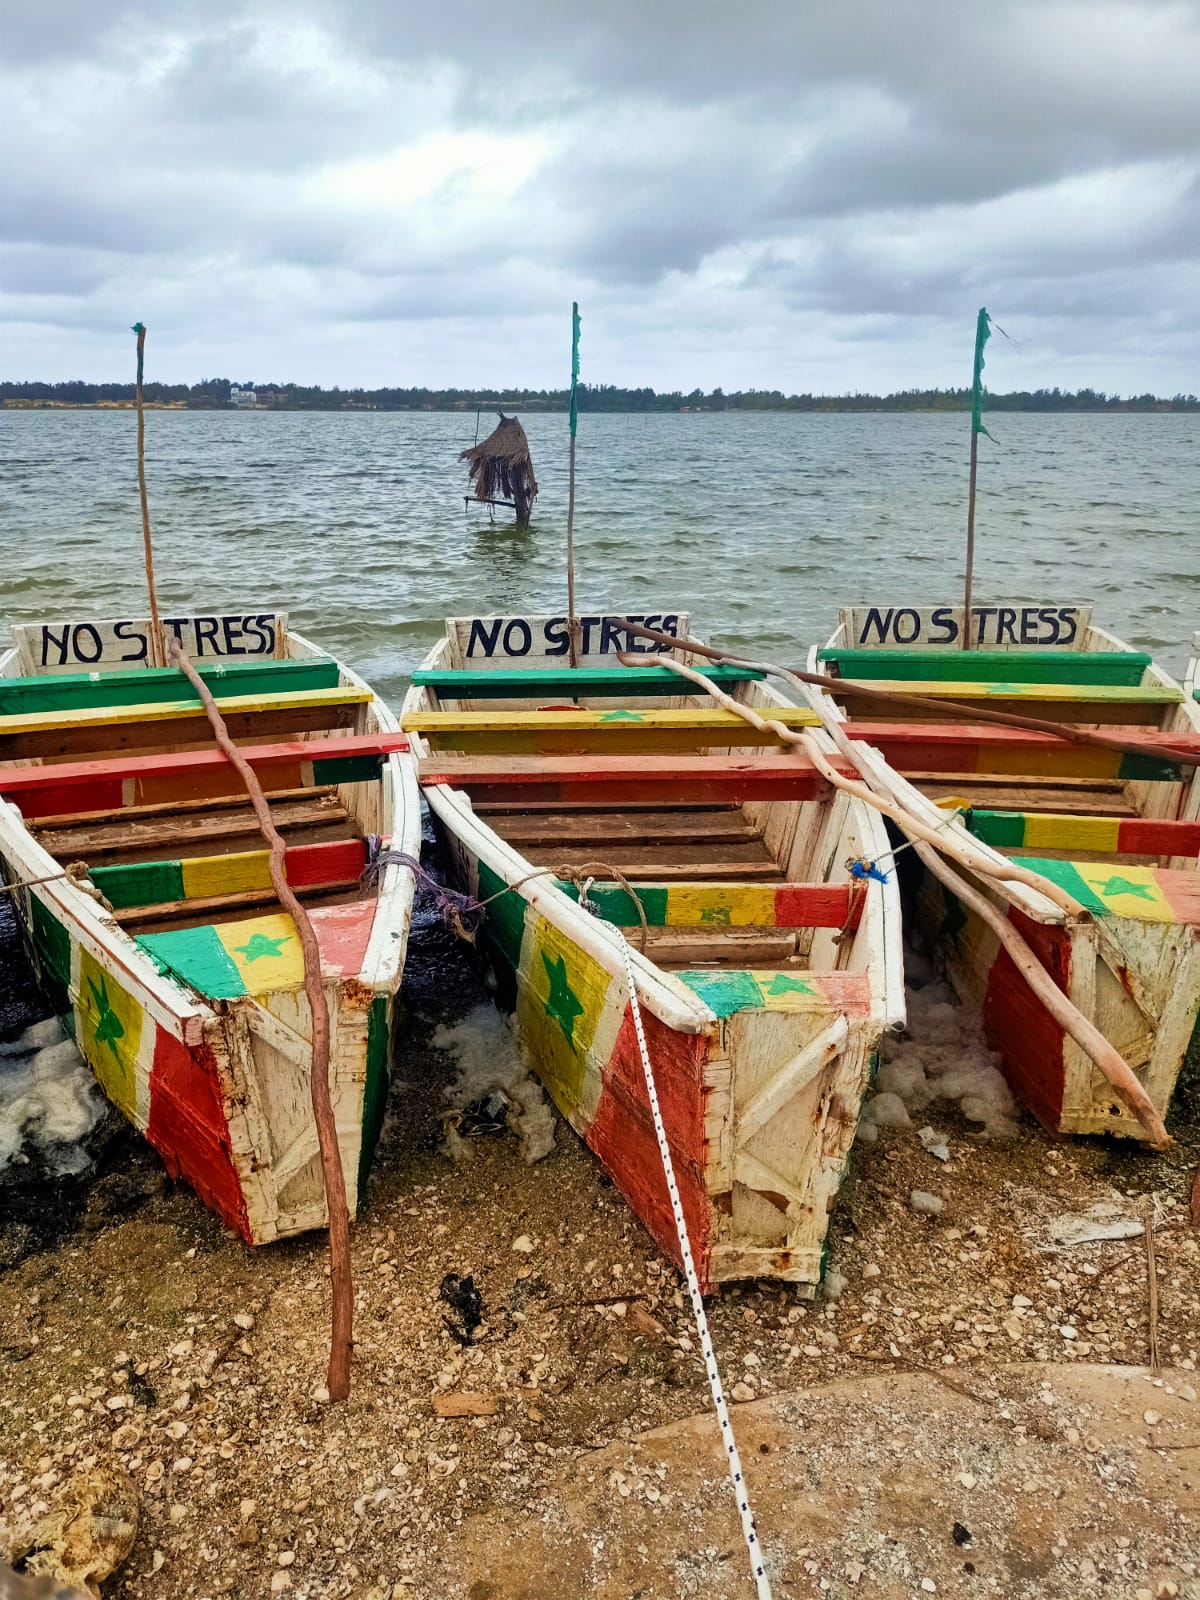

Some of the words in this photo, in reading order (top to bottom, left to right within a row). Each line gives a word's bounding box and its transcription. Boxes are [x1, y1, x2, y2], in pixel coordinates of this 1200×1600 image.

[41, 624, 102, 666] NO
[466, 618, 532, 657] NO
[859, 608, 920, 643] NO
